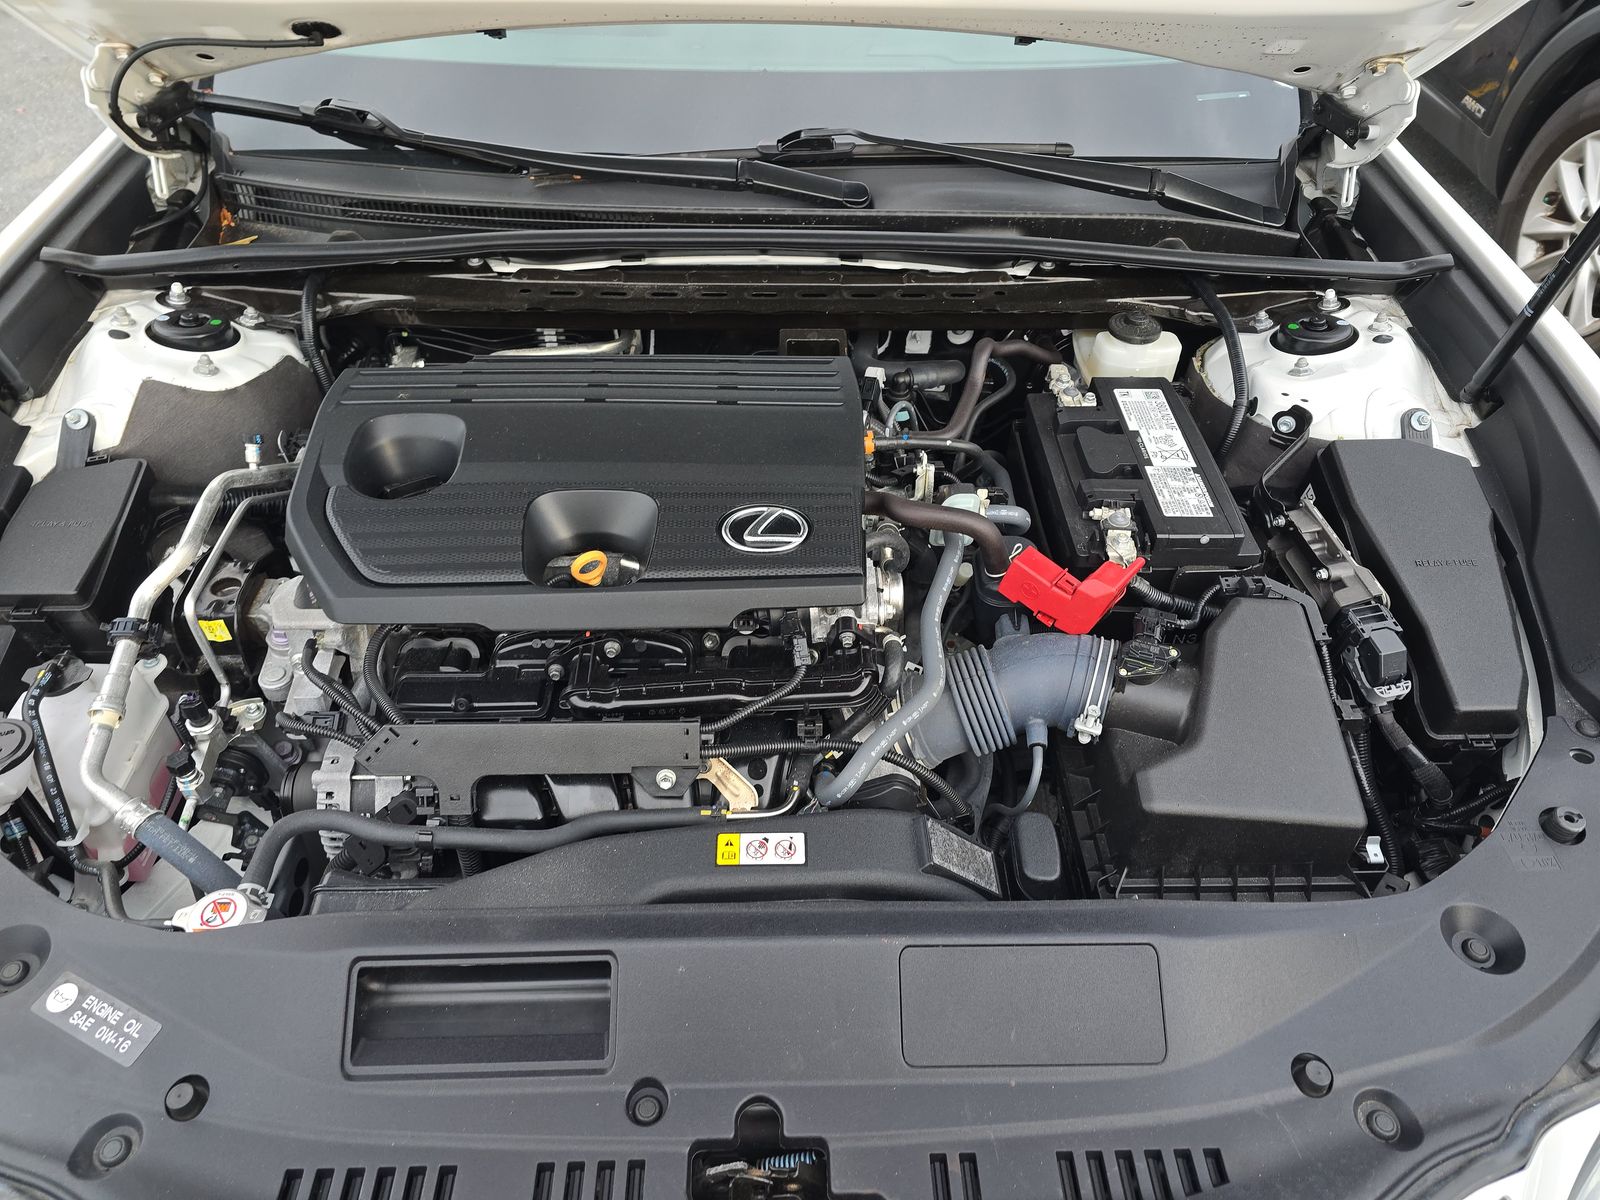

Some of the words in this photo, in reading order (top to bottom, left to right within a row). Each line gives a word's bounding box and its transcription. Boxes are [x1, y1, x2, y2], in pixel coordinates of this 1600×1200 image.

[69, 1010, 96, 1032] SAE
[94, 1025, 132, 1053] 0W-16
[82, 995, 124, 1026] ENGINE
[123, 1018, 143, 1039] OIL
